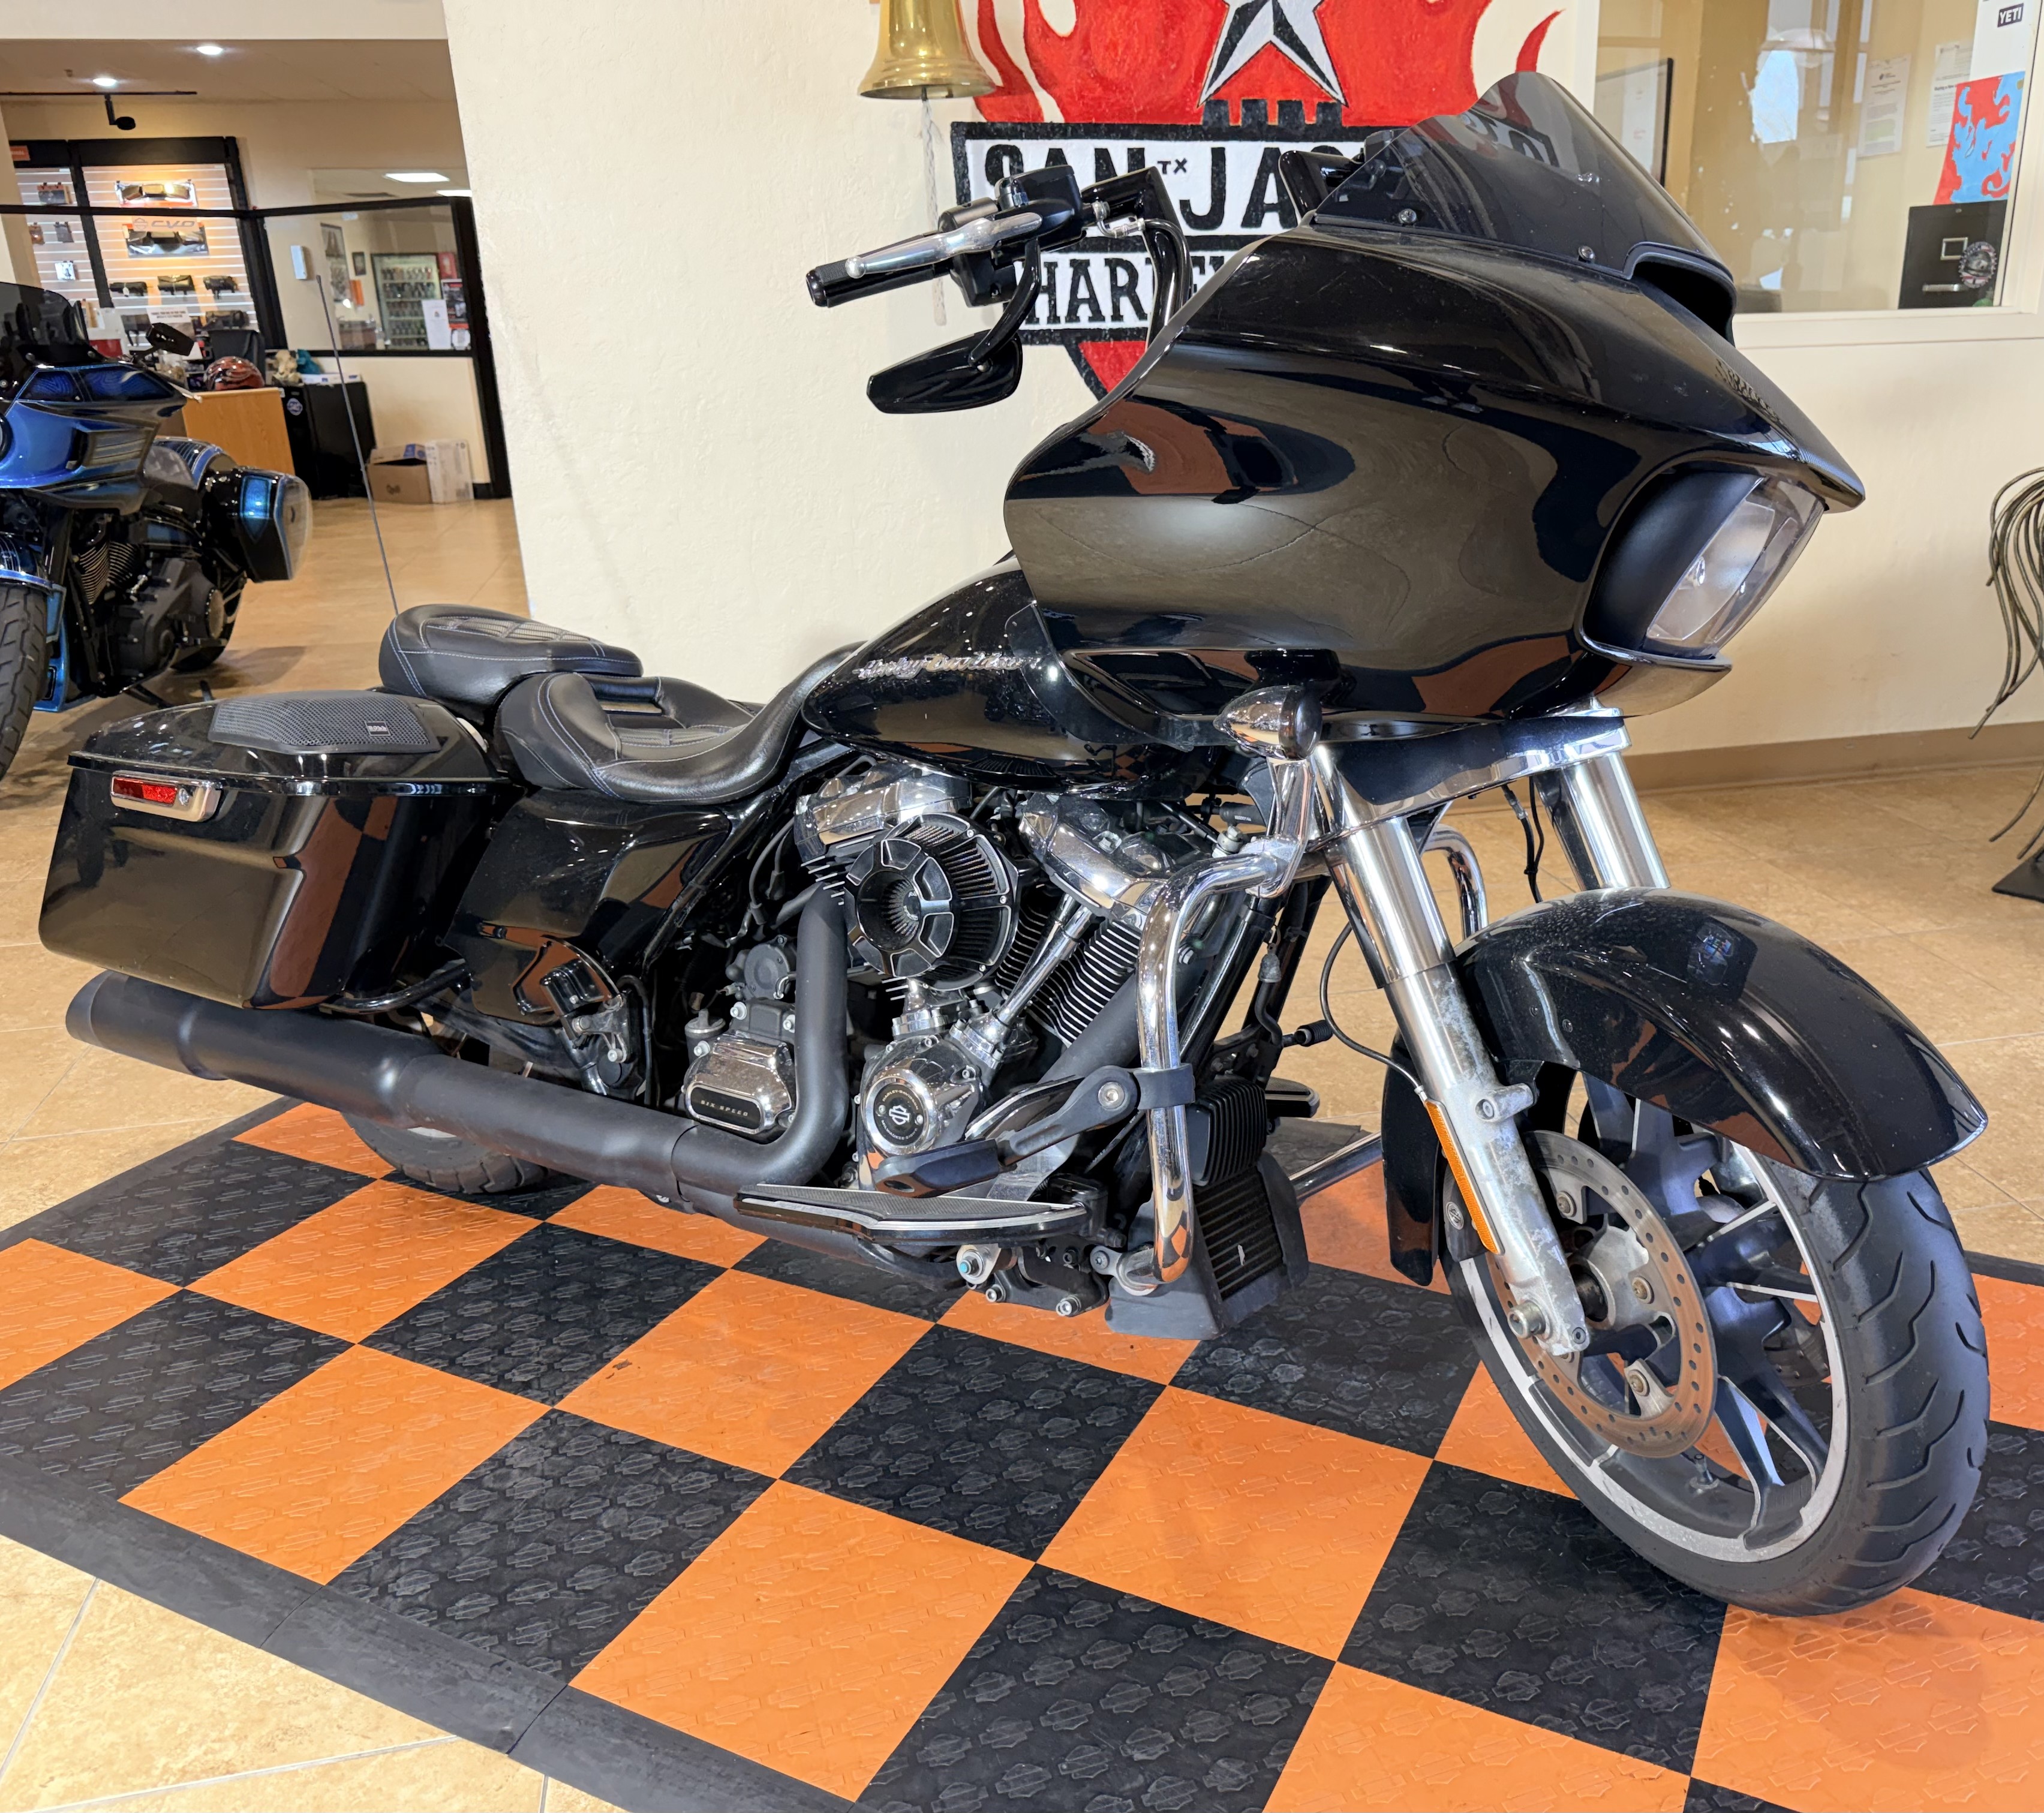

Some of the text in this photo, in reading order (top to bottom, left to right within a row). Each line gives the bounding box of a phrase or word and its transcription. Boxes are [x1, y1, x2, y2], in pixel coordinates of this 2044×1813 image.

[2000, 6, 2022, 24] YETI
[1158, 158, 1188, 175] TX
[151, 220, 195, 228] CVO
[720, 1105, 749, 1117] SPEED
